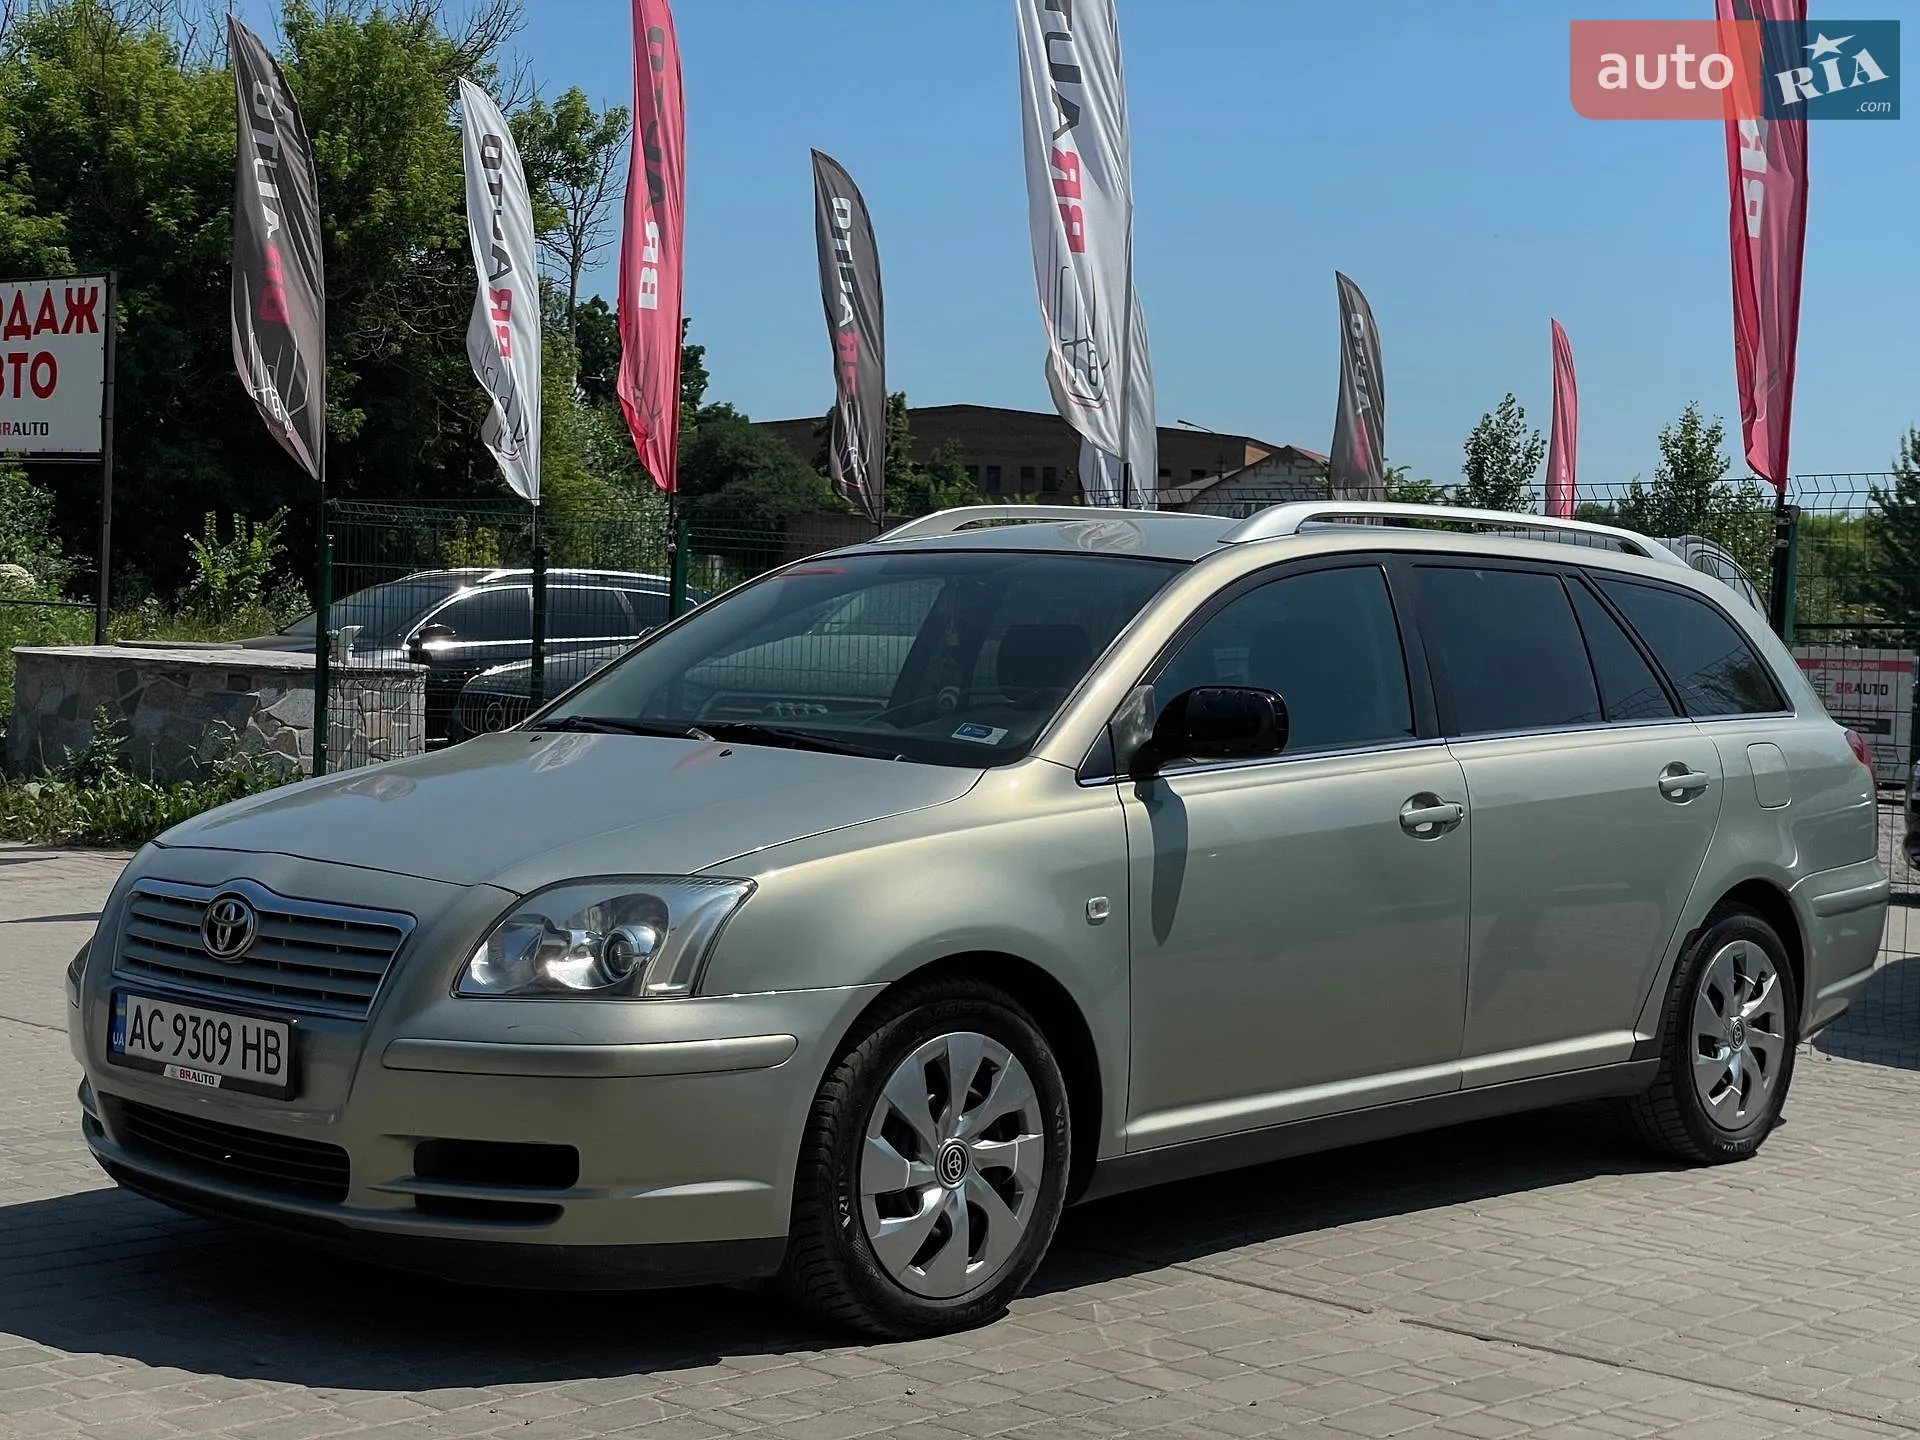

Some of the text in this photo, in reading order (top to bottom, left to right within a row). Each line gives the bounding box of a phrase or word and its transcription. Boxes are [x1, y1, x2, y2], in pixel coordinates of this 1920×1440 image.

[0, 287, 99, 341] ДАЖ
[0, 351, 58, 399] ТО
[0, 422, 49, 436] RAUTO
[1835, 682, 1888, 696] BRAUTO
[112, 1031, 125, 1047] UA
[128, 1004, 282, 1075] AC 9309 HB
[179, 1068, 215, 1086] BRAUTO
